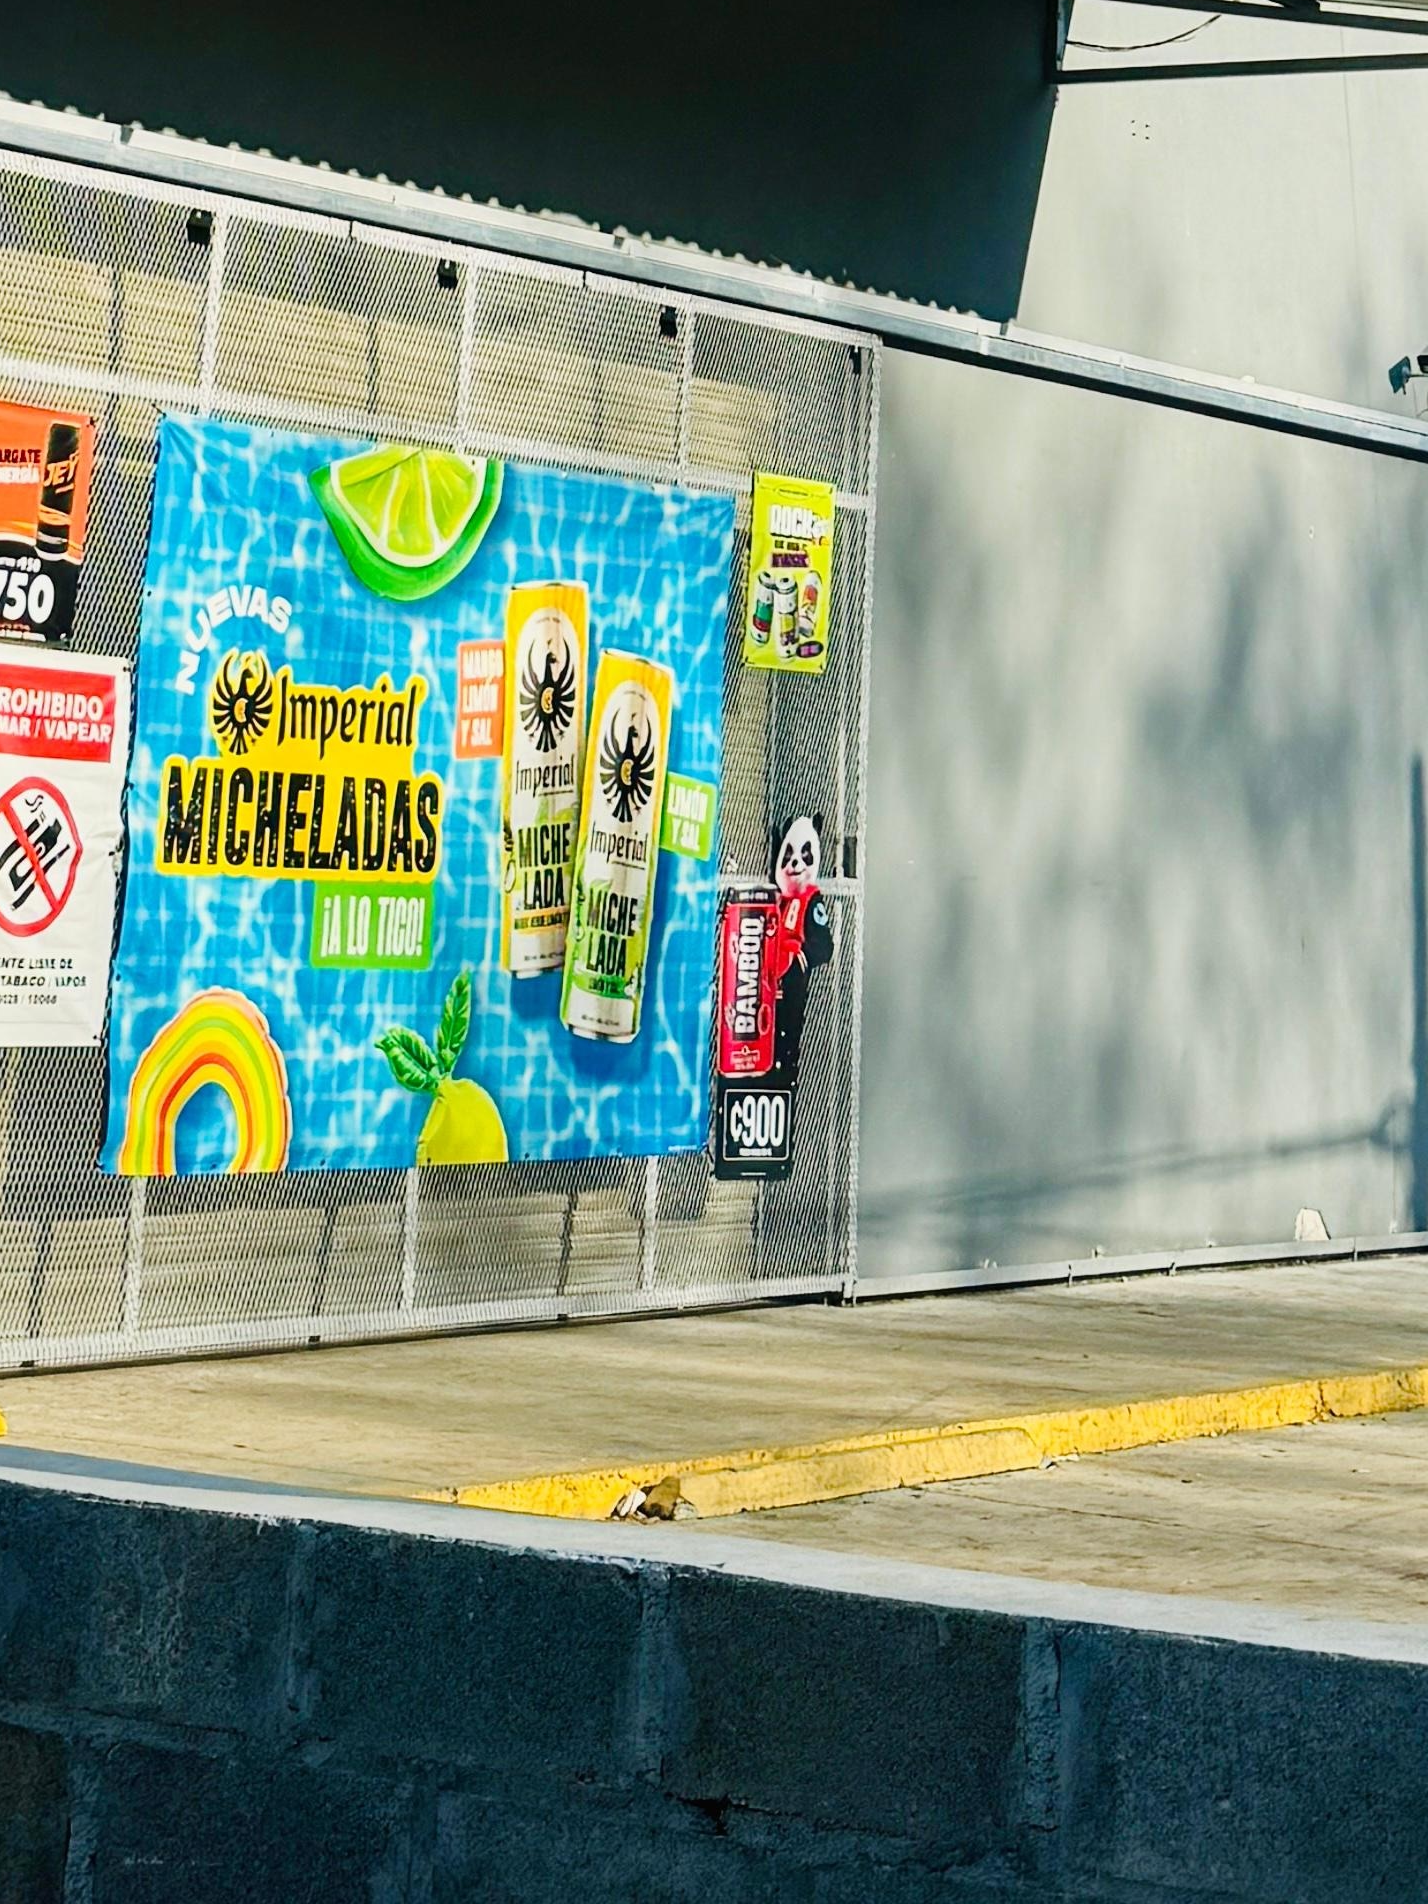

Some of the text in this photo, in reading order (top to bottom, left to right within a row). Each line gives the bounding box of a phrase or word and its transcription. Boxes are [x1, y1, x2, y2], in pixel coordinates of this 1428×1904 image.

[175, 584, 293, 696] NUEVAS
[462, 675, 499, 714] LIMÓN
[43, 719, 114, 743] VAPEAR
[277, 674, 418, 760] Imperial
[461, 717, 493, 747] Y SAL
[515, 753, 576, 798] Imperial
[163, 765, 440, 873] MICHELADAS
[667, 784, 709, 824] LIMÓN
[518, 822, 572, 868] MICHE
[590, 820, 651, 864] Imperial
[671, 818, 682, 845] Y
[523, 867, 566, 911] LADA
[320, 895, 427, 958] ¡A LO TICO!
[586, 886, 639, 937] MICHE
[59, 957, 73, 970] DE
[586, 932, 627, 978] LADA
[0, 975, 46, 988] TABACO
